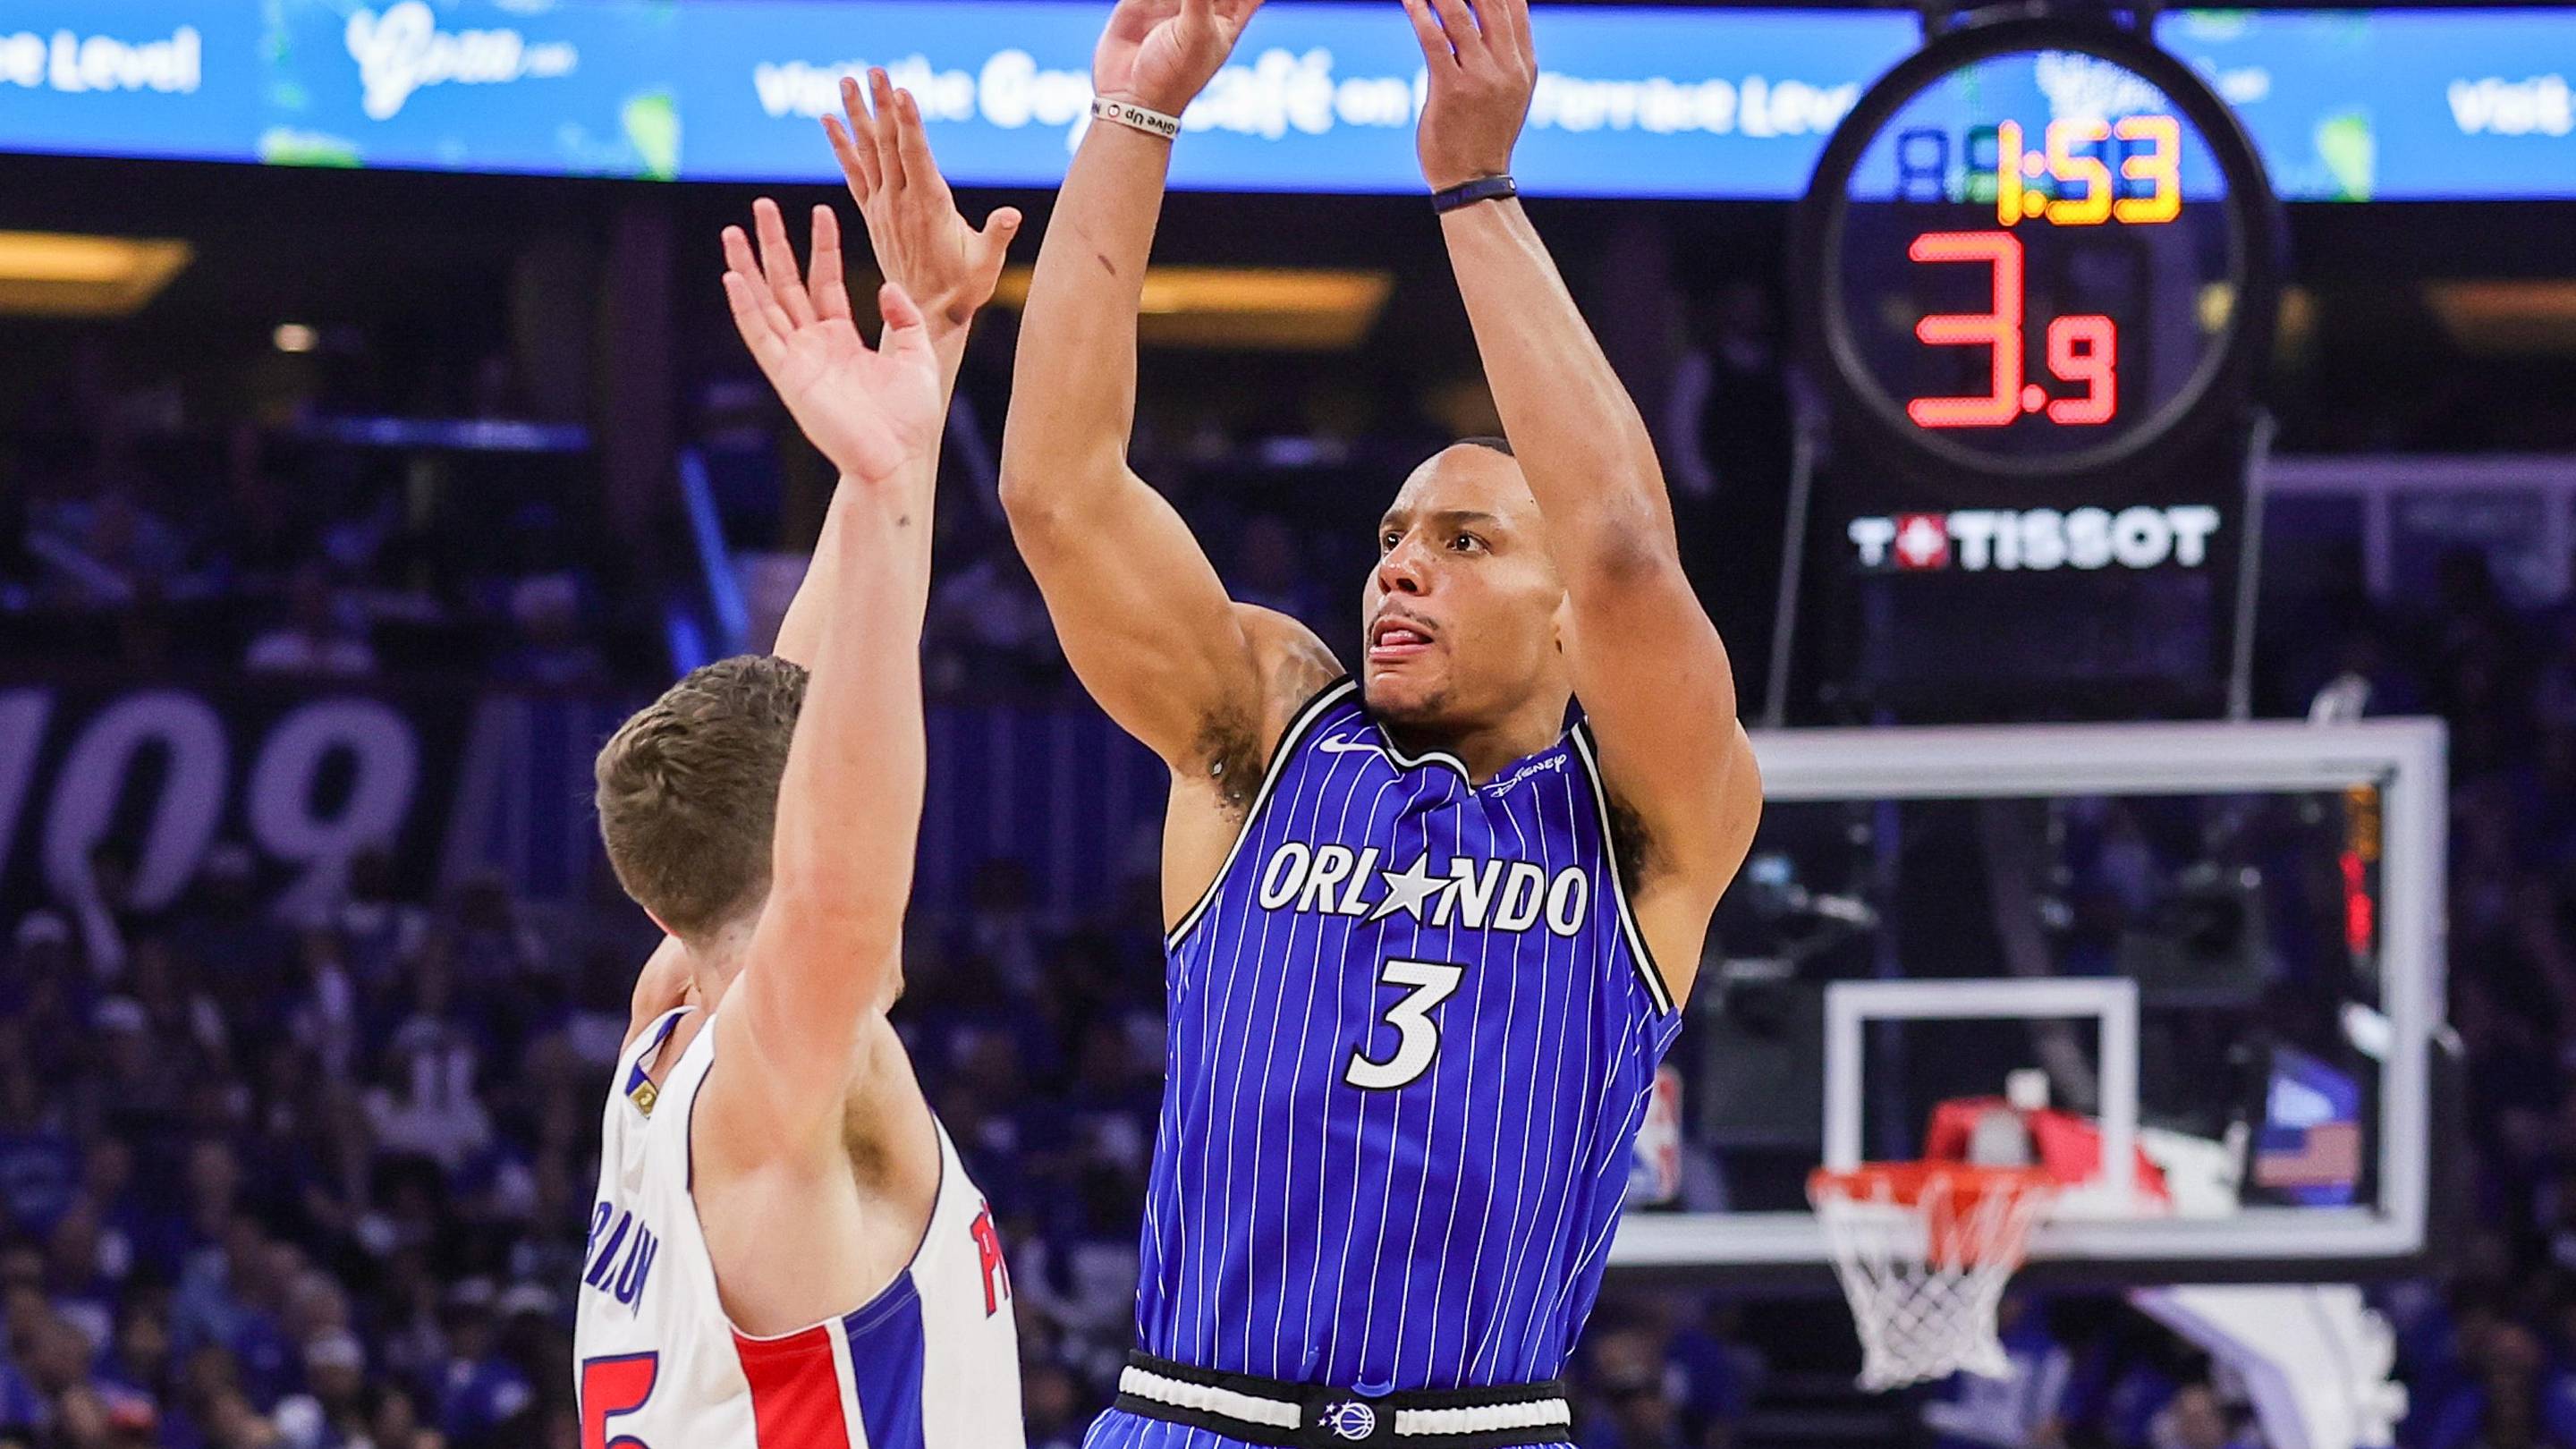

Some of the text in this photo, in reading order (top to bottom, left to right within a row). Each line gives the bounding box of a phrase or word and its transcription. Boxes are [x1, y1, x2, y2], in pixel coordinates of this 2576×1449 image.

[1125, 108, 1145, 125] Up
[1147, 116, 1175, 135] Give
[1998, 115, 2182, 226] 1:53
[1907, 231, 2118, 428] 3.9
[1946, 506, 2221, 571] TISSOT
[1344, 959, 1463, 1090] 3
